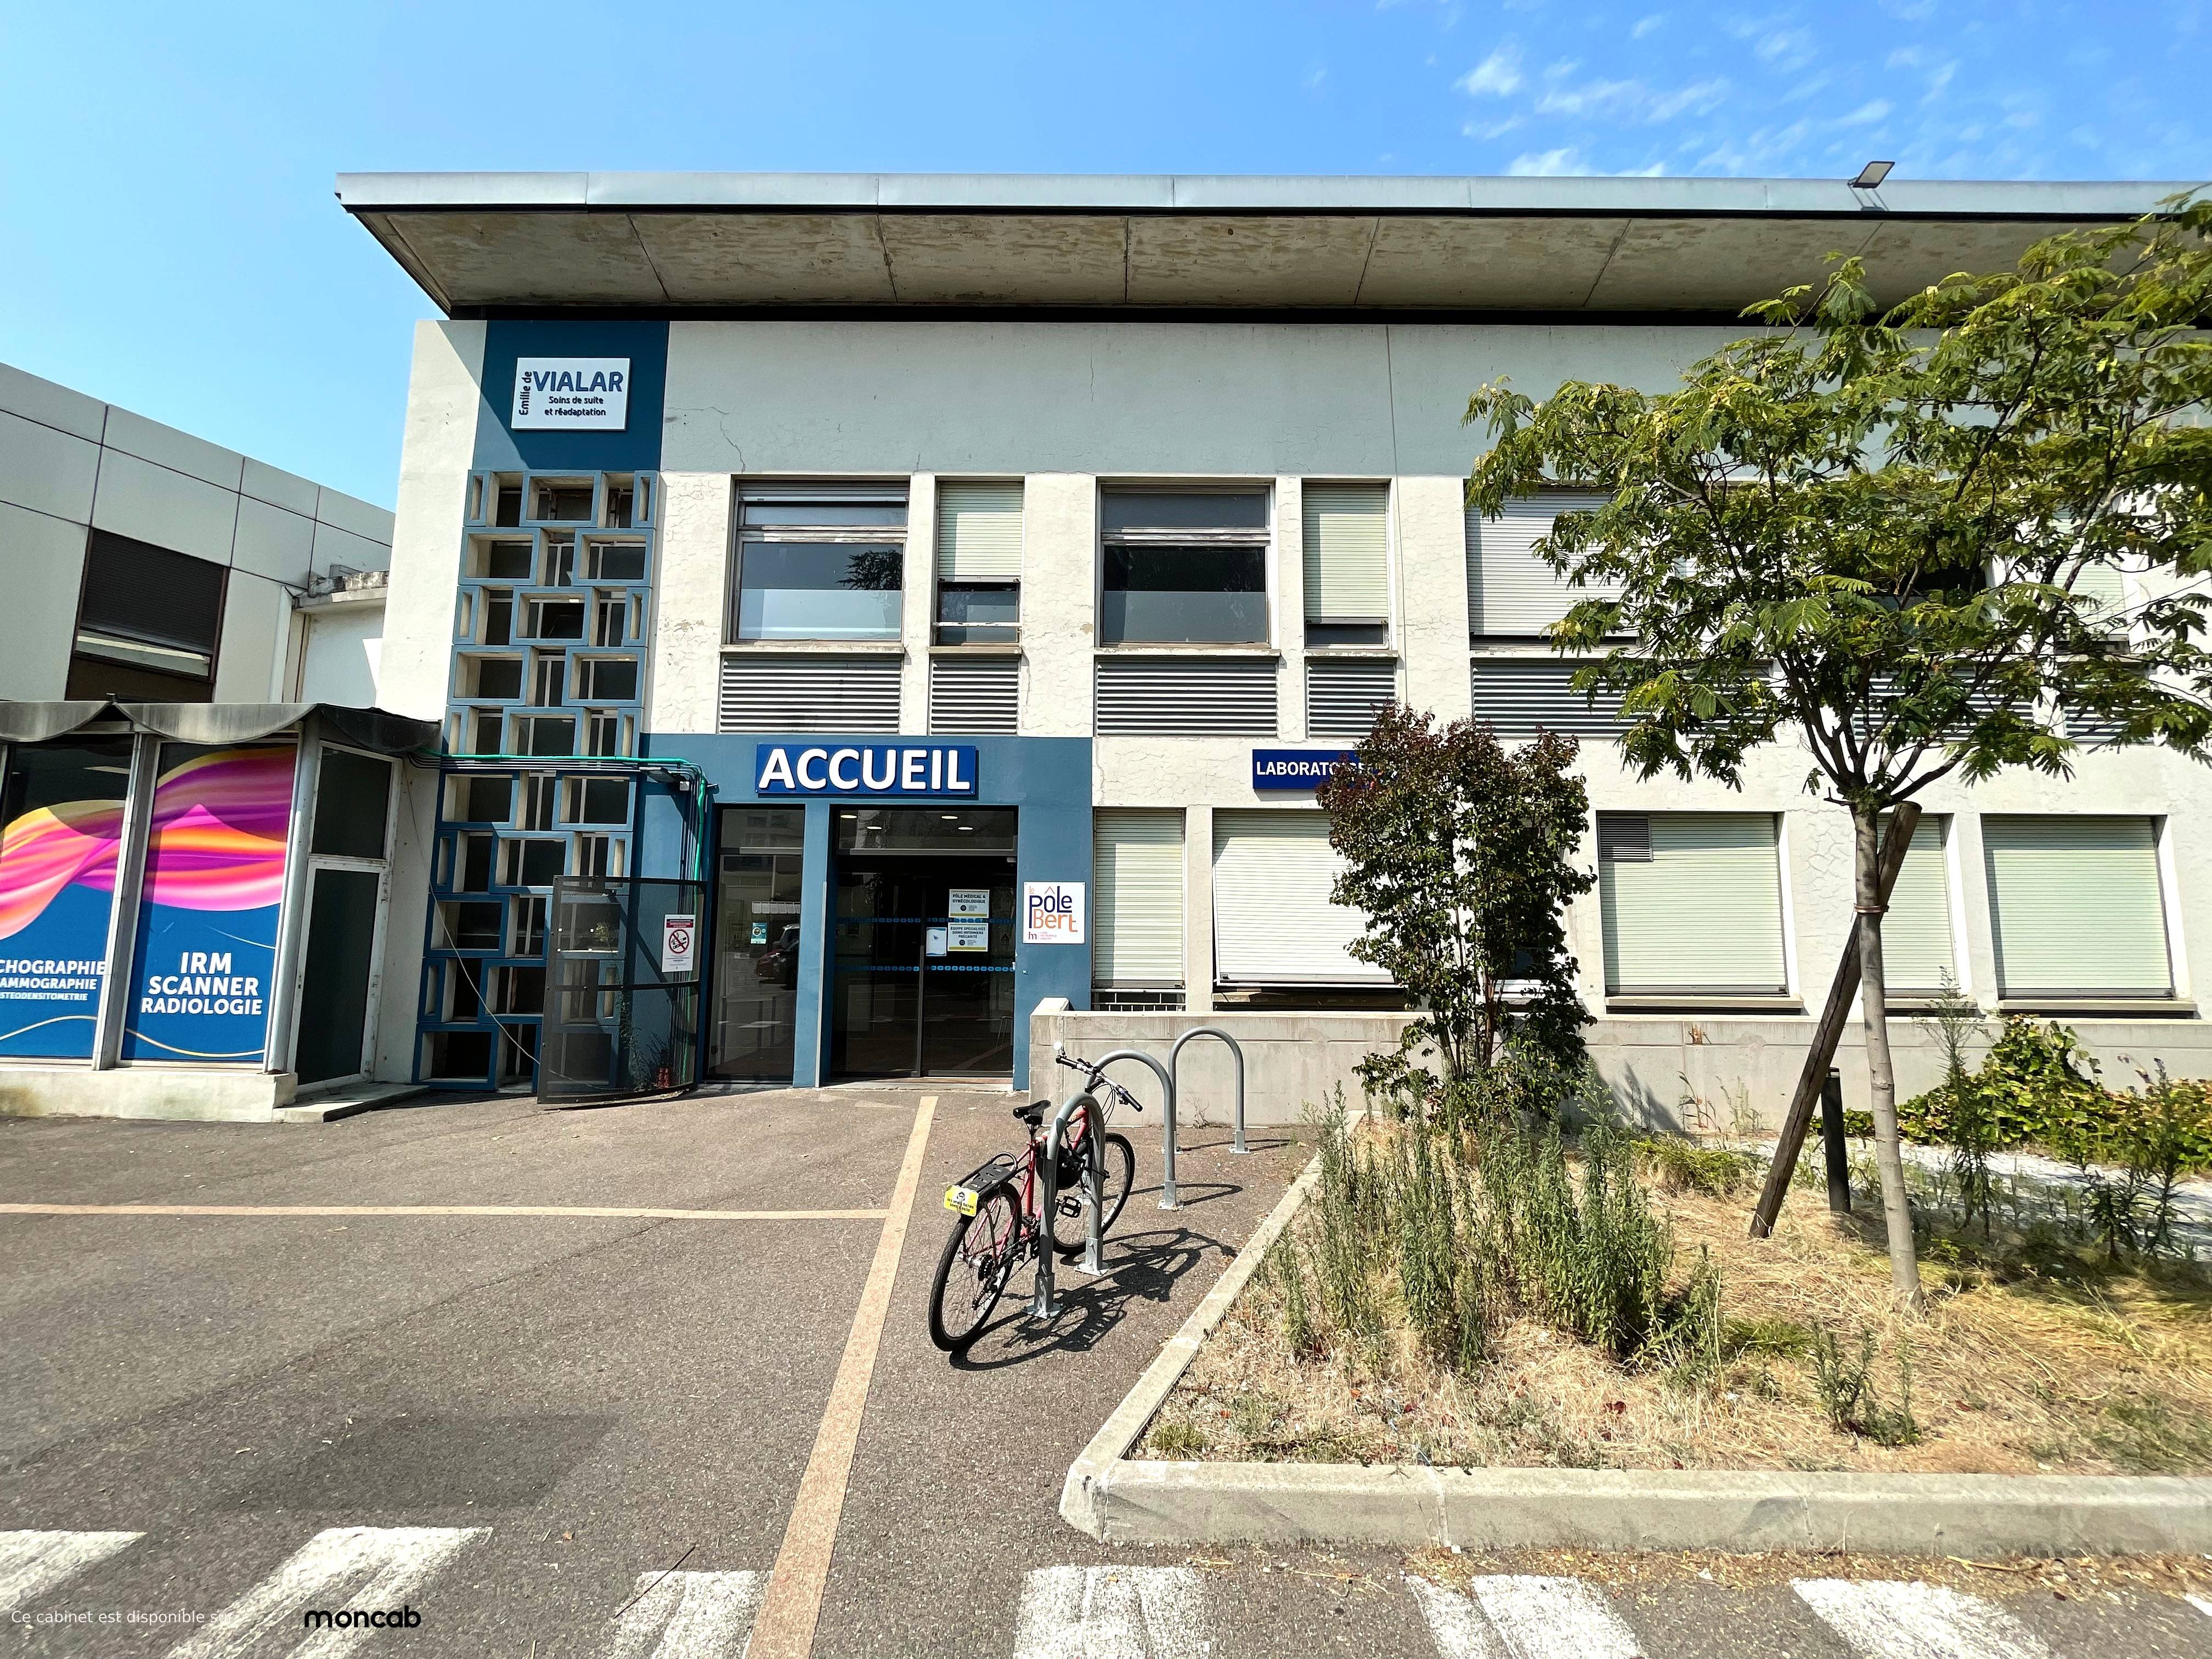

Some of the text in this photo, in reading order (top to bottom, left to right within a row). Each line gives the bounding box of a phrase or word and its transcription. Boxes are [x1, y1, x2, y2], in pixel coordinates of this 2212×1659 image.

[533, 371, 623, 392] VIALAR
[518, 371, 532, 415] Emilie de
[549, 396, 603, 404] Soins de suite
[555, 407, 606, 417] réadaptation
[758, 748, 970, 790] ACCUEIL
[1033, 909, 1078, 932] Bert
[0, 959, 106, 975] CHOGRAPHIE
[180, 951, 232, 975] IRM
[0, 977, 98, 990] AMMOGRAPHIE
[148, 976, 259, 996] SCANNER
[0, 992, 88, 1001] STEODENSITOMETRIE
[140, 997, 263, 1015] RADIOLOGIE
